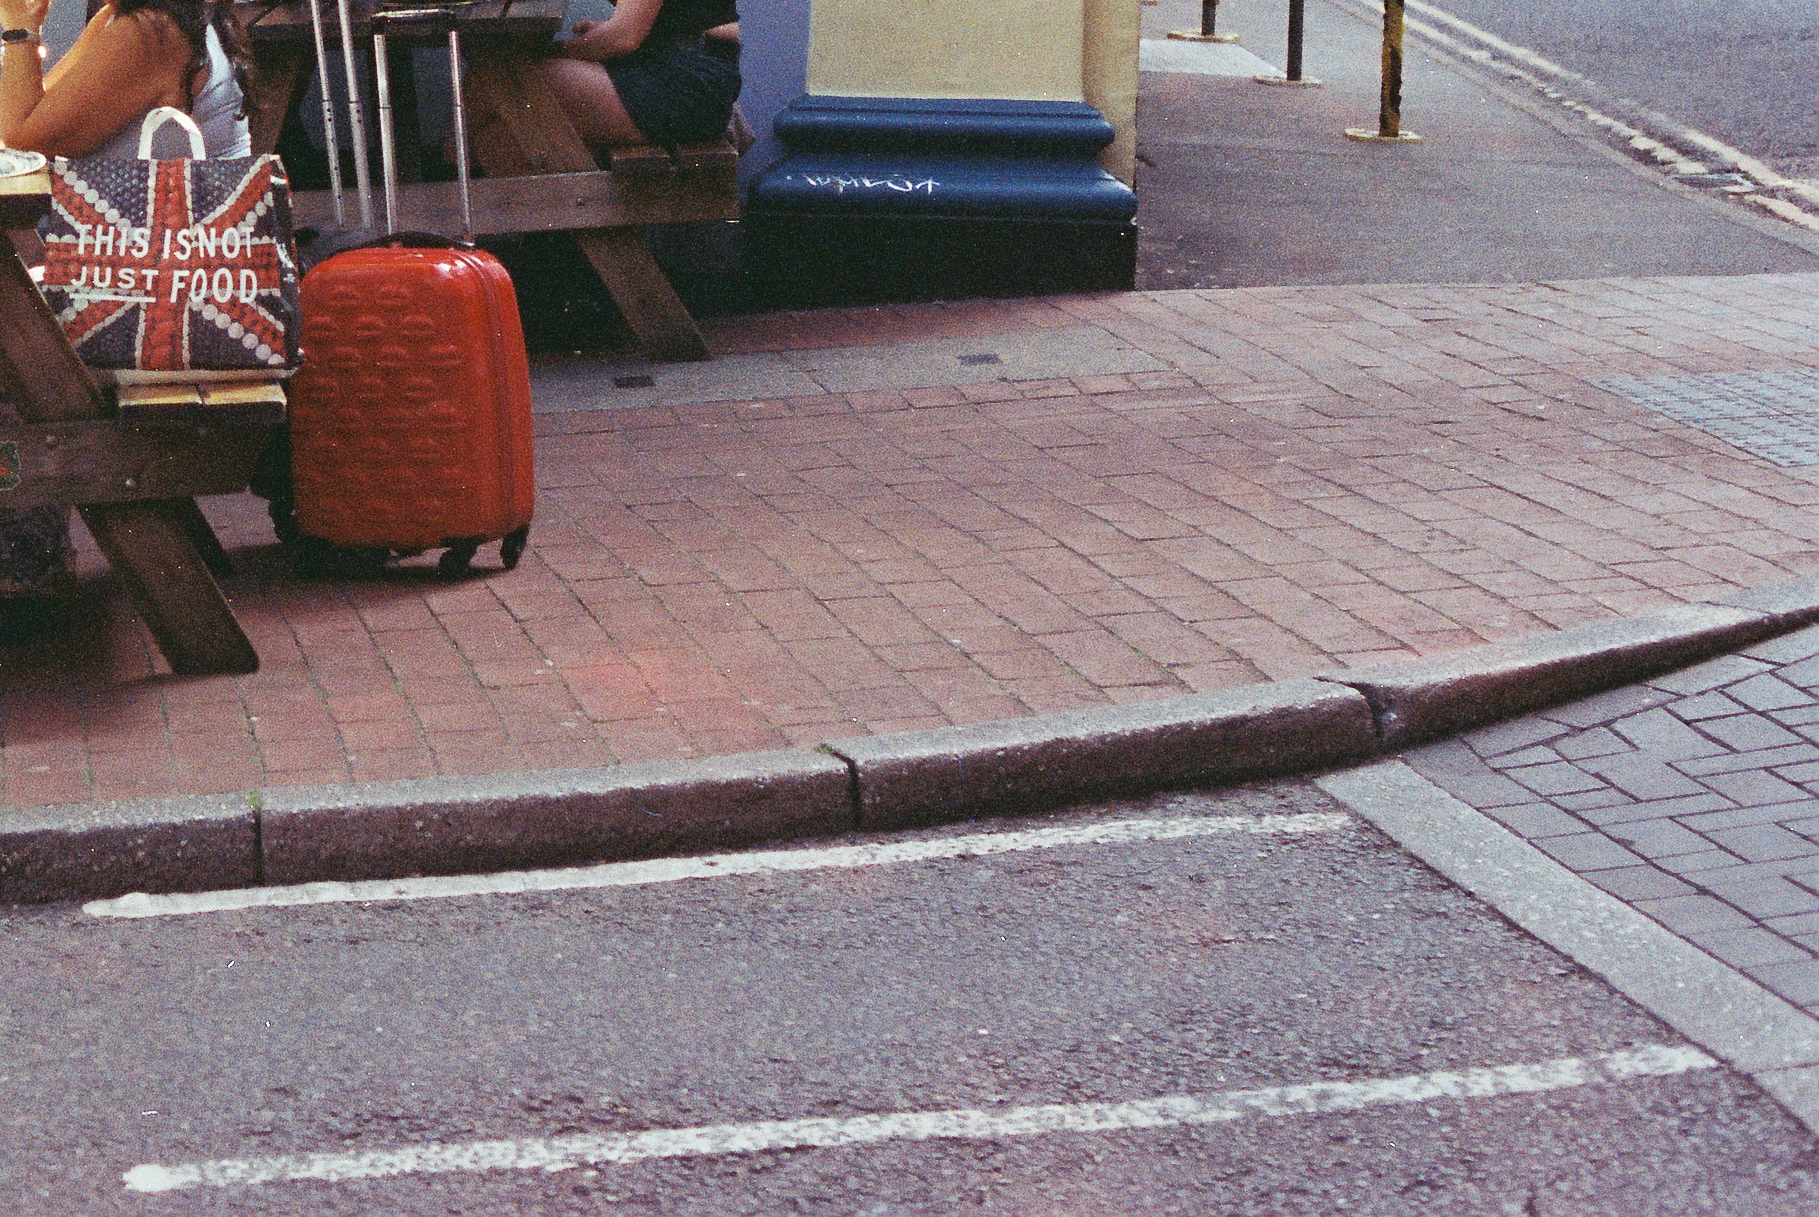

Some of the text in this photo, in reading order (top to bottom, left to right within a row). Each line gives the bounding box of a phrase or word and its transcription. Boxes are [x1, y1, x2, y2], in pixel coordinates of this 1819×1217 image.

[76, 223, 150, 259] THIS
[70, 266, 258, 304] JUST FOOD
